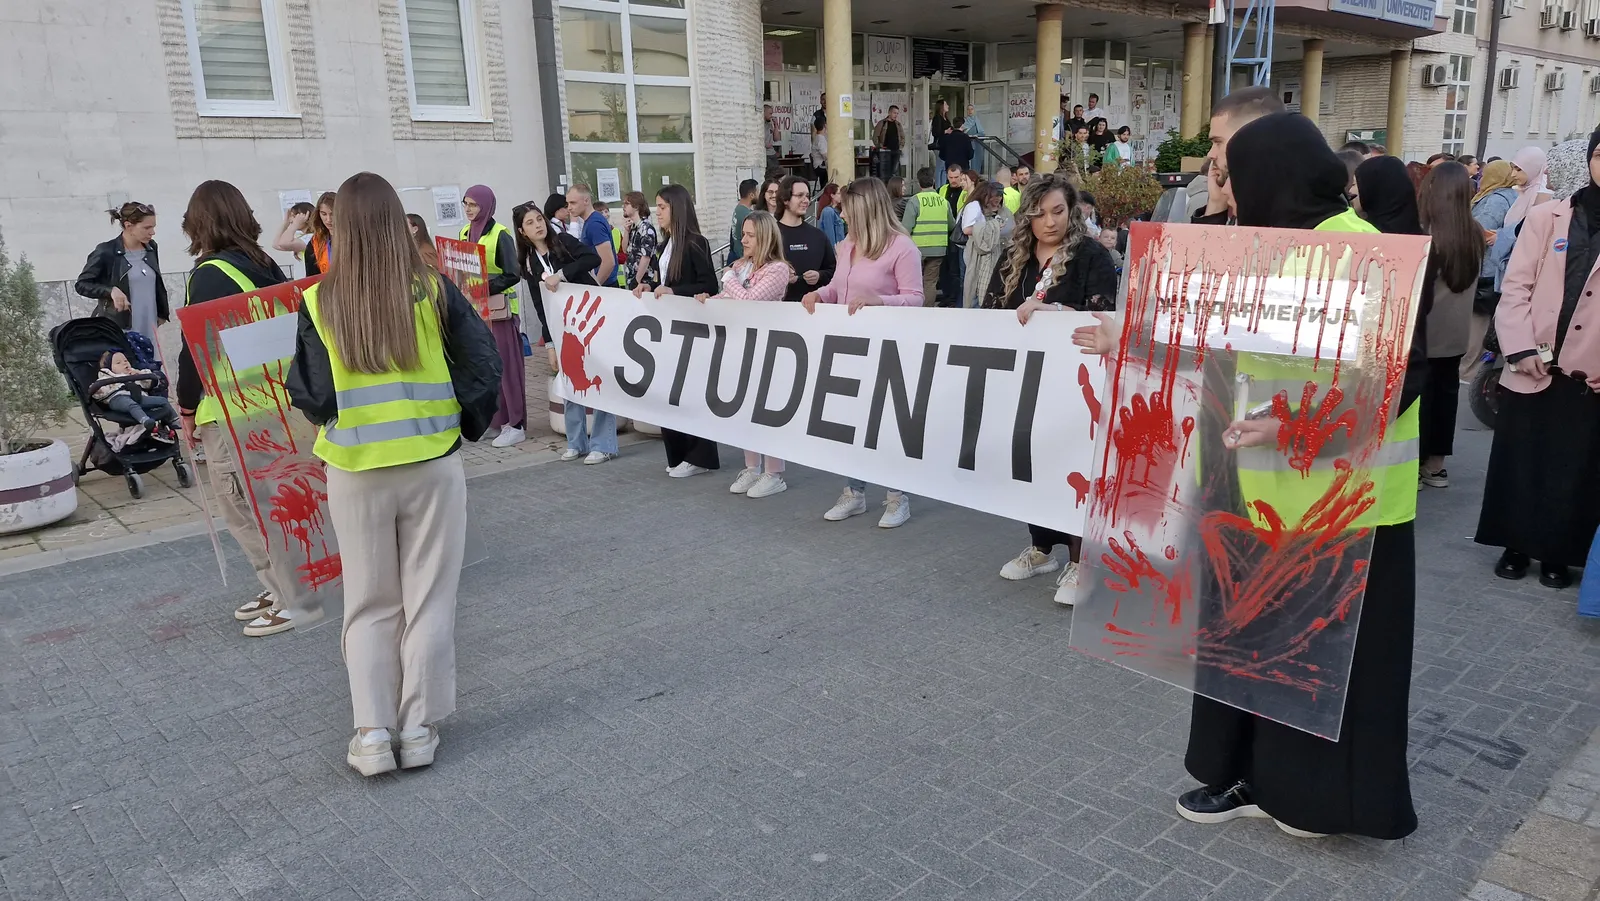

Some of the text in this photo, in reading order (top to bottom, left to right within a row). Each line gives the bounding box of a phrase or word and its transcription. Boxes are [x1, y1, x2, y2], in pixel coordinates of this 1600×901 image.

[1340, 0, 1433, 21] AVNI UNIVERZITET
[876, 41, 901, 54] DUNP
[873, 62, 905, 73] BLOKADI
[613, 314, 1046, 483] STUDENTI
